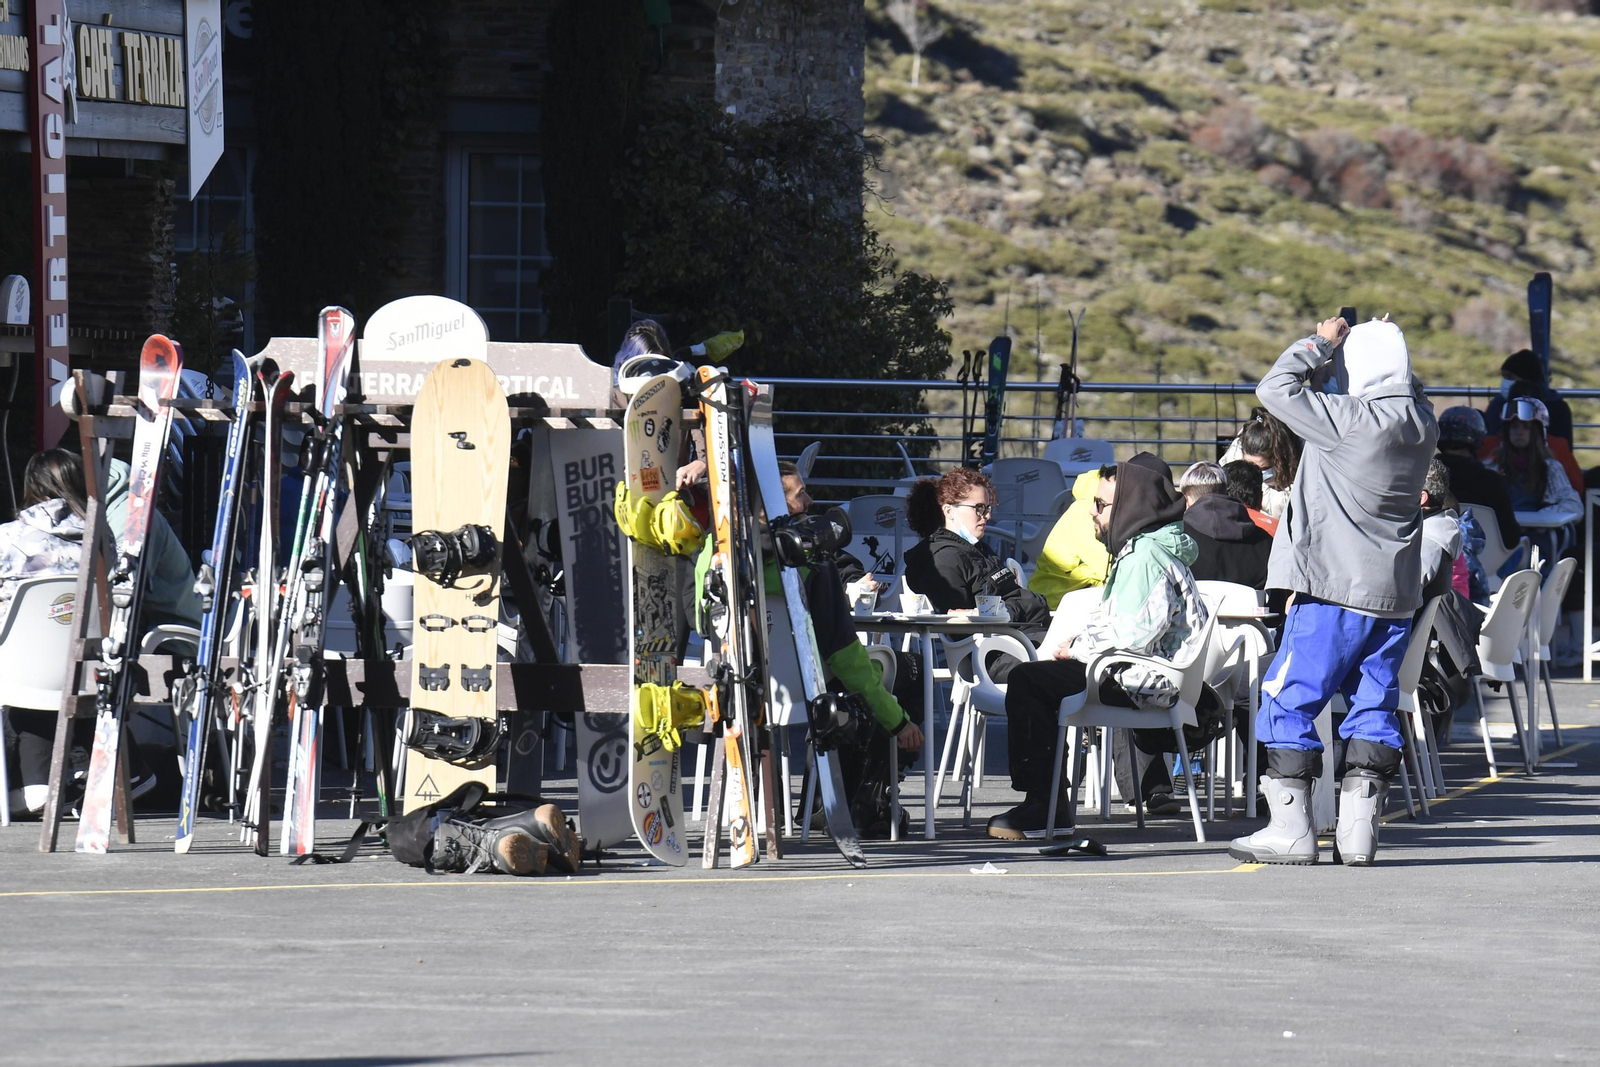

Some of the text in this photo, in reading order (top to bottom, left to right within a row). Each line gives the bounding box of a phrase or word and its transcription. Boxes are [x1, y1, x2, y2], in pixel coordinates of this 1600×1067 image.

[121, 32, 185, 107] TERRAZA
[42, 13, 68, 407] VERTICAL
[350, 371, 424, 396] TERRA
[496, 374, 580, 399] RTICAL
[564, 452, 615, 486] BUR
[717, 414, 728, 482] ROSSIGN
[566, 476, 616, 510] BUR
